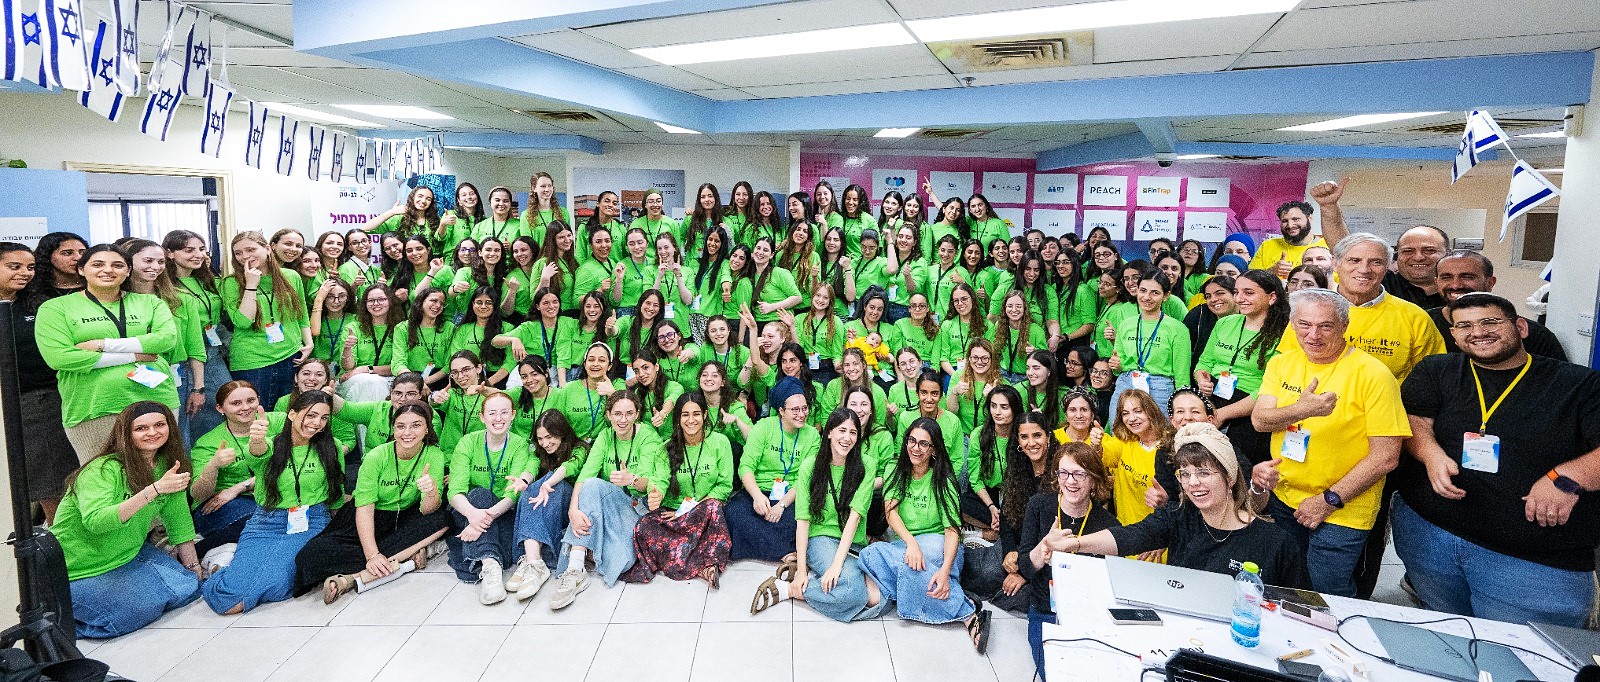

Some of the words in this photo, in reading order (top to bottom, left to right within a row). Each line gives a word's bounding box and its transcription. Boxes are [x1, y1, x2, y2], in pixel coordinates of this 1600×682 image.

[1089, 186, 1121, 195] PEACH
[1147, 187, 1171, 195] FinTrap
[329, 212, 367, 224] מתחיל
[1166, 579, 1185, 590] hp
